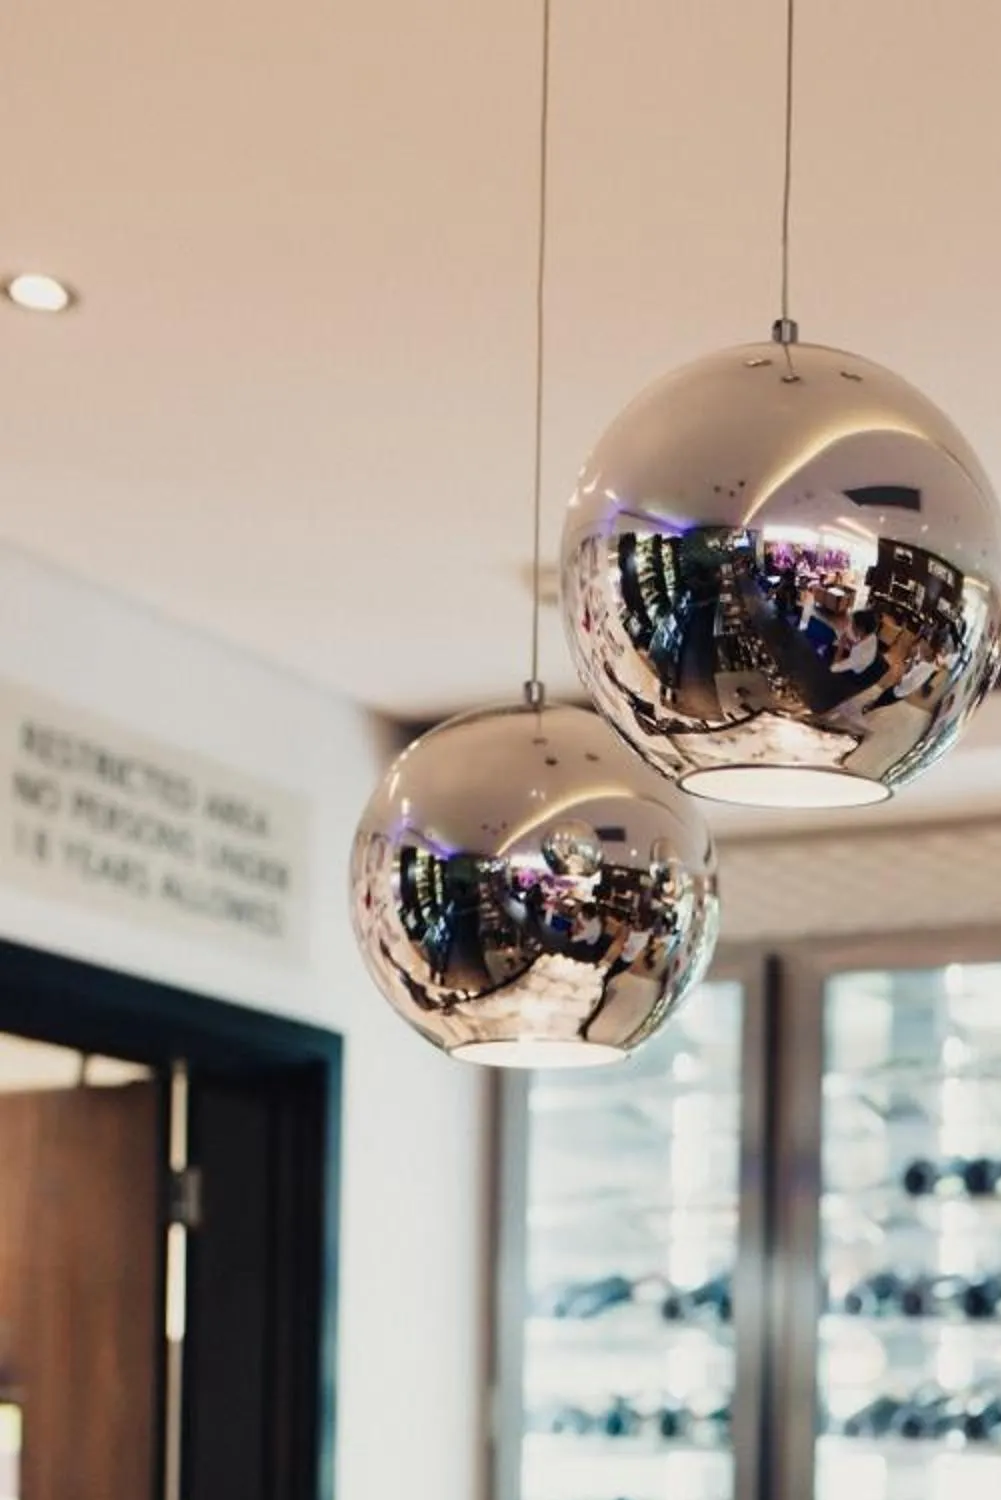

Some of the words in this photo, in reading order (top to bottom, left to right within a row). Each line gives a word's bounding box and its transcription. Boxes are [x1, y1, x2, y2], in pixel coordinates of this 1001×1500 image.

[22, 721, 195, 811] RESTRICTED
[204, 793, 268, 838] AREA
[71, 789, 195, 861] PERSONS
